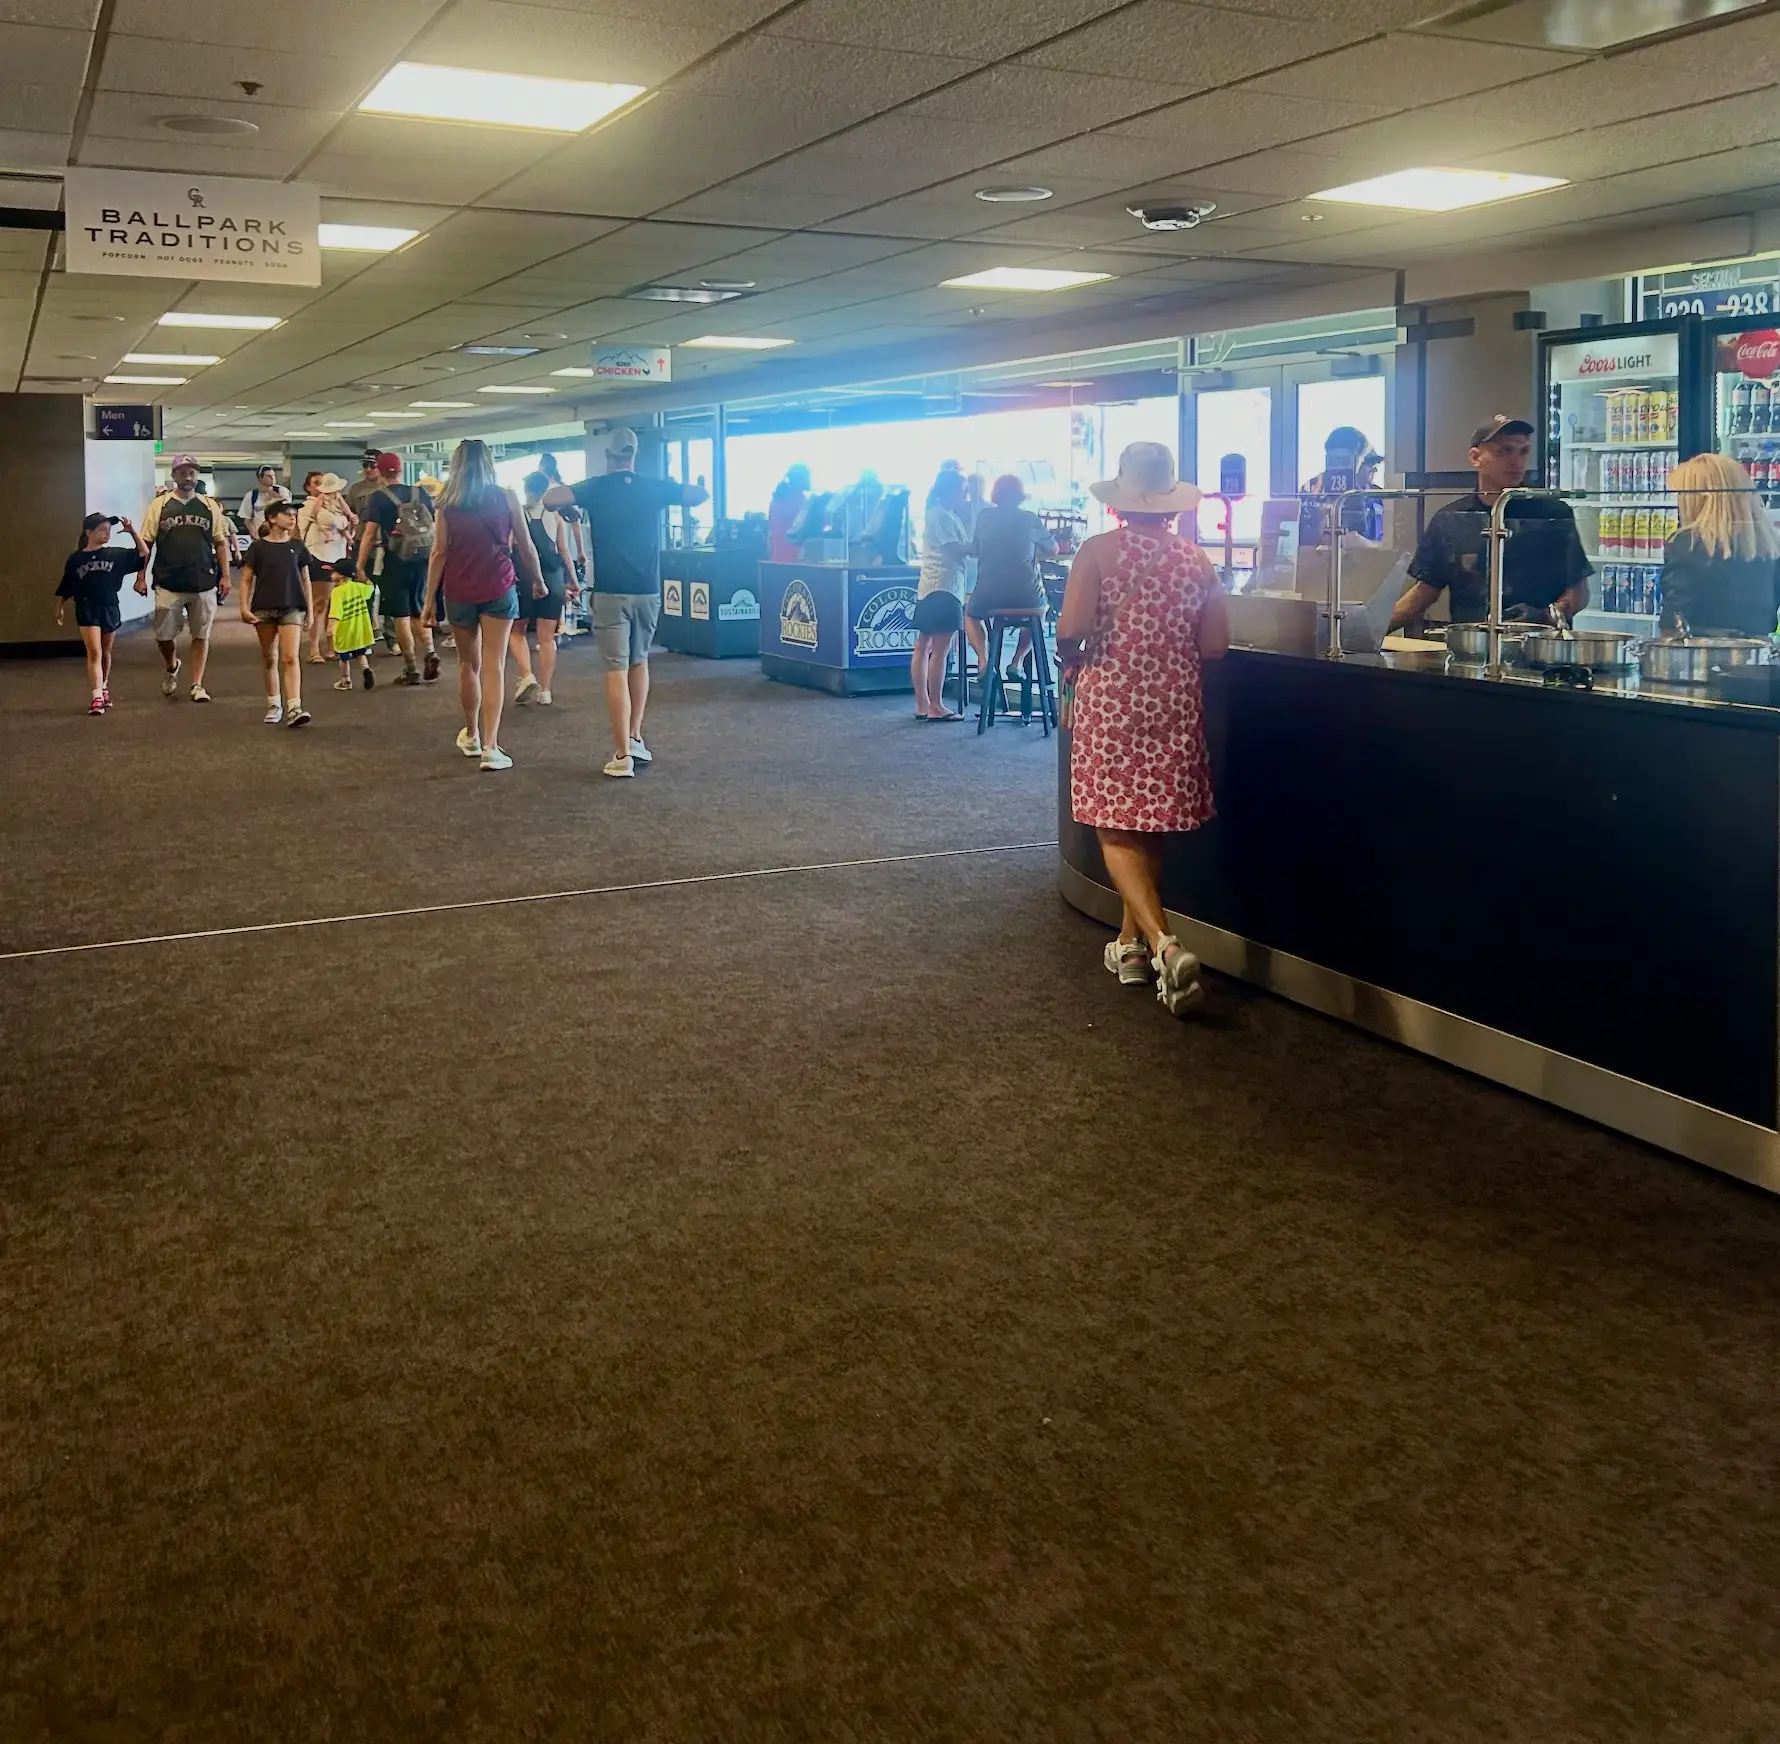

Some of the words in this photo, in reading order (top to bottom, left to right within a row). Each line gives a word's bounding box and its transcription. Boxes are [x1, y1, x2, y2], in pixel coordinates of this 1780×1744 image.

[101, 208, 287, 235] BALLPARK
[84, 227, 305, 255] TRADITIONS
[102, 252, 146, 260] POPCORN
[214, 258, 255, 267] PEANUTS
[596, 366, 641, 376] CHICKEN
[1579, 354, 1616, 373] Coors
[1617, 354, 1652, 370] LIGHT
[101, 410, 125, 420] Men
[1331, 475, 1347, 491] 238
[863, 590, 918, 623] COLORA
[782, 619, 817, 642] ROCKIES
[859, 631, 917, 649] ROCKI
